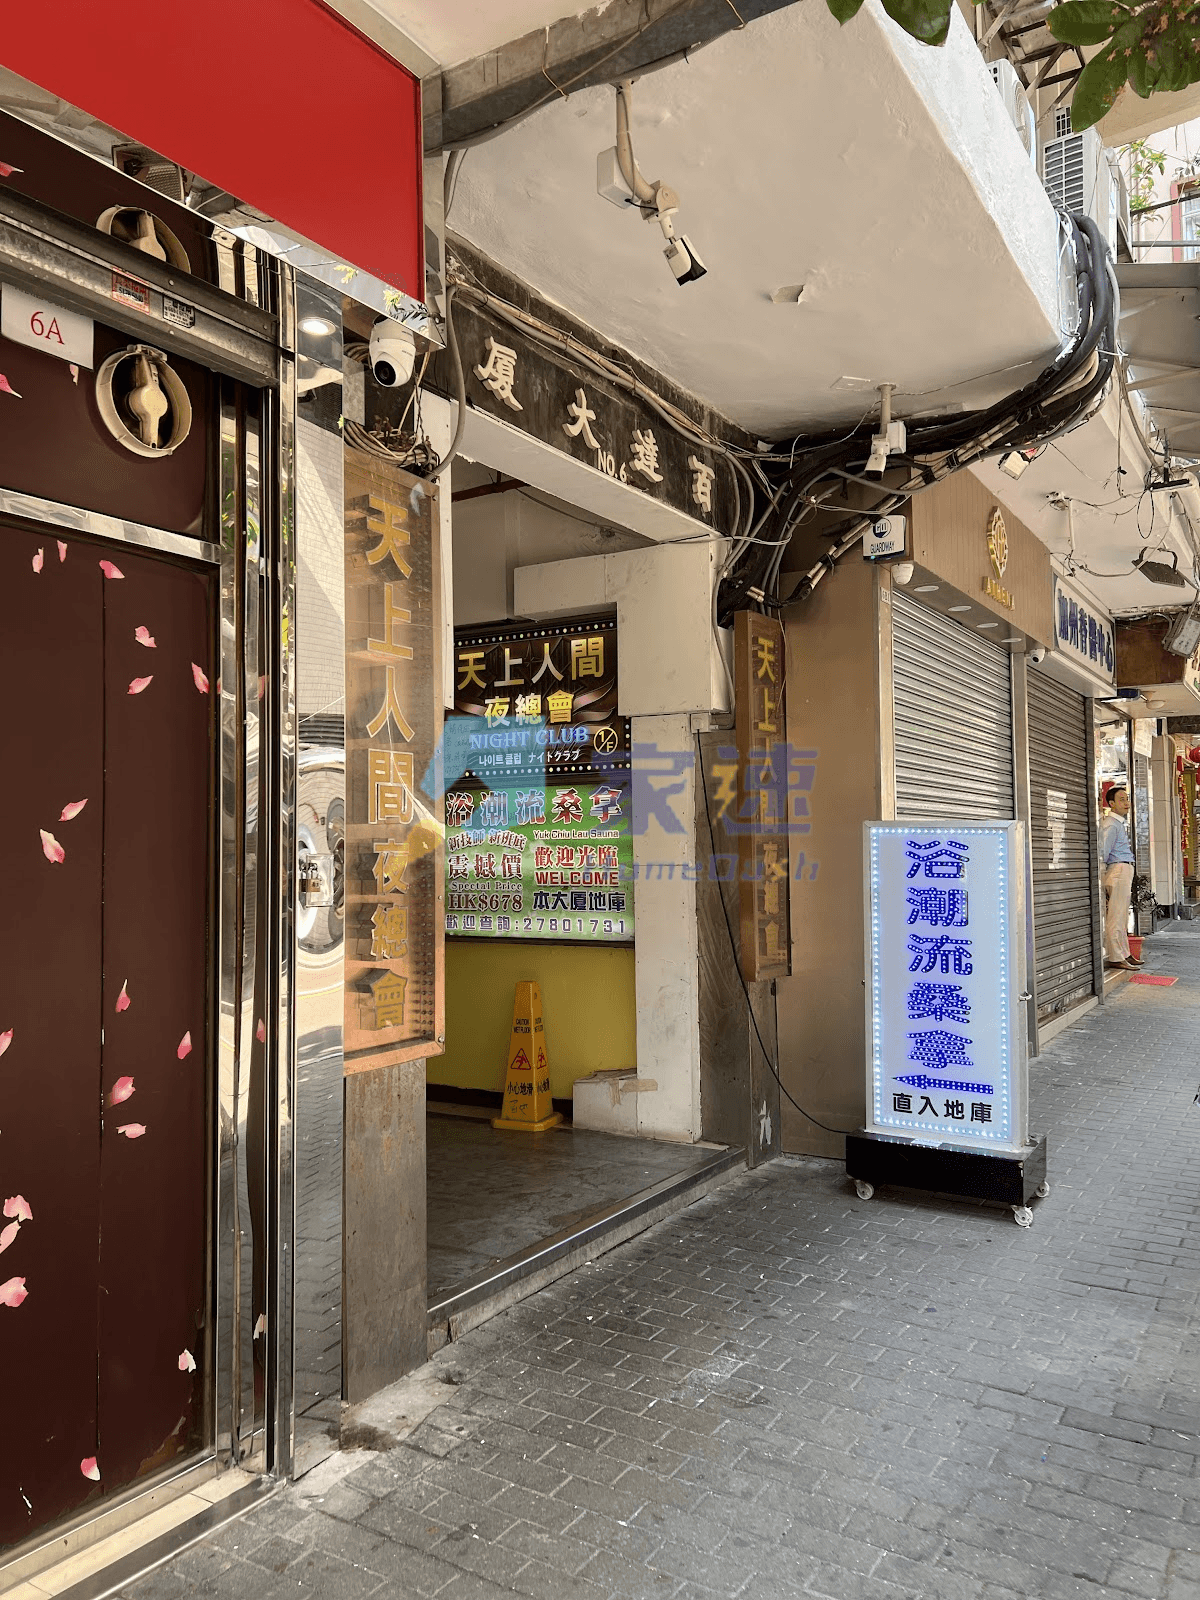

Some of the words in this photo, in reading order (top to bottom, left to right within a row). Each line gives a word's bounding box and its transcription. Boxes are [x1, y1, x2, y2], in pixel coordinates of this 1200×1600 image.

[30, 311, 65, 345] 6A
[598, 448, 628, 483] NO.6
[870, 540, 895, 554] GUARDWAY
[457, 636, 605, 691] 天上人間
[484, 689, 575, 729] 夜總會
[469, 731, 530, 750] NIGHT
[534, 727, 590, 745] CLUB
[364, 495, 416, 1031] 天上人間夜總會
[528, 749, 581, 764] ナイトクラブ
[446, 785, 623, 826] 浴潮流桑拿
[533, 830, 549, 839] Yuk
[551, 830, 570, 839] Chiu
[572, 829, 588, 838] Lau
[590, 829, 619, 838] Sauna
[448, 853, 523, 880] 震撼價
[534, 845, 619, 869] 歡迎光臨
[495, 881, 523, 891] Price
[534, 871, 619, 886] WELCOME
[448, 893, 523, 912] HK$678
[533, 890, 627, 912] 本大廈地庫
[905, 840, 974, 1069] 浴潮流桑拿
[507, 1081, 534, 1096] 小心地滑
[892, 1092, 993, 1124] 直入地庫
